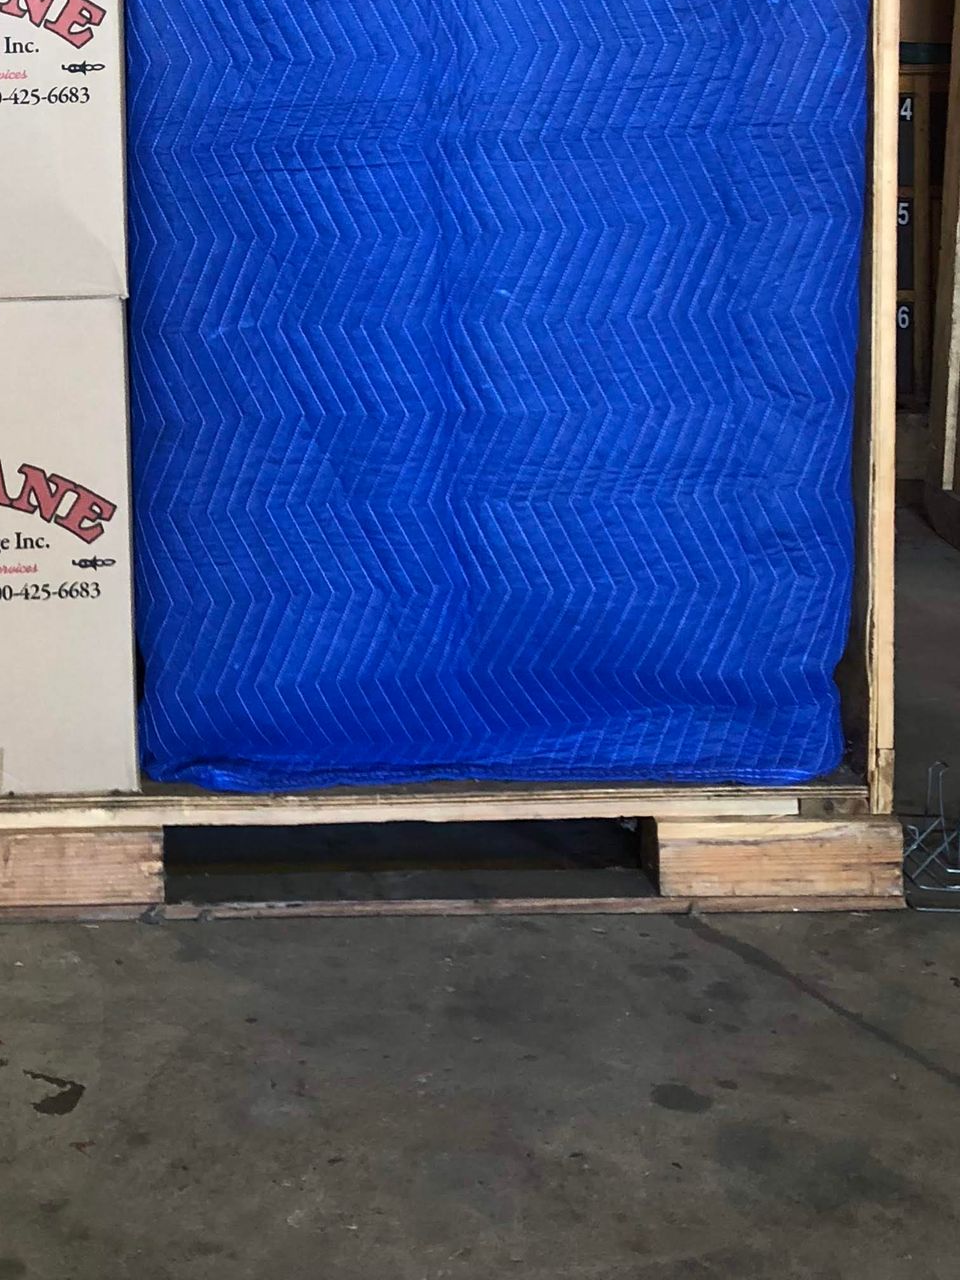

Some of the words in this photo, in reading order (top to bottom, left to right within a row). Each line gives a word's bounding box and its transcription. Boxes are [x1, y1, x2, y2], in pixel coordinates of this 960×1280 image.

[4, 36, 40, 54] Inc.
[900, 97, 912, 120] 4
[898, 202, 909, 225] 5
[898, 306, 909, 328] 6
[14, 532, 50, 551] Inc.
